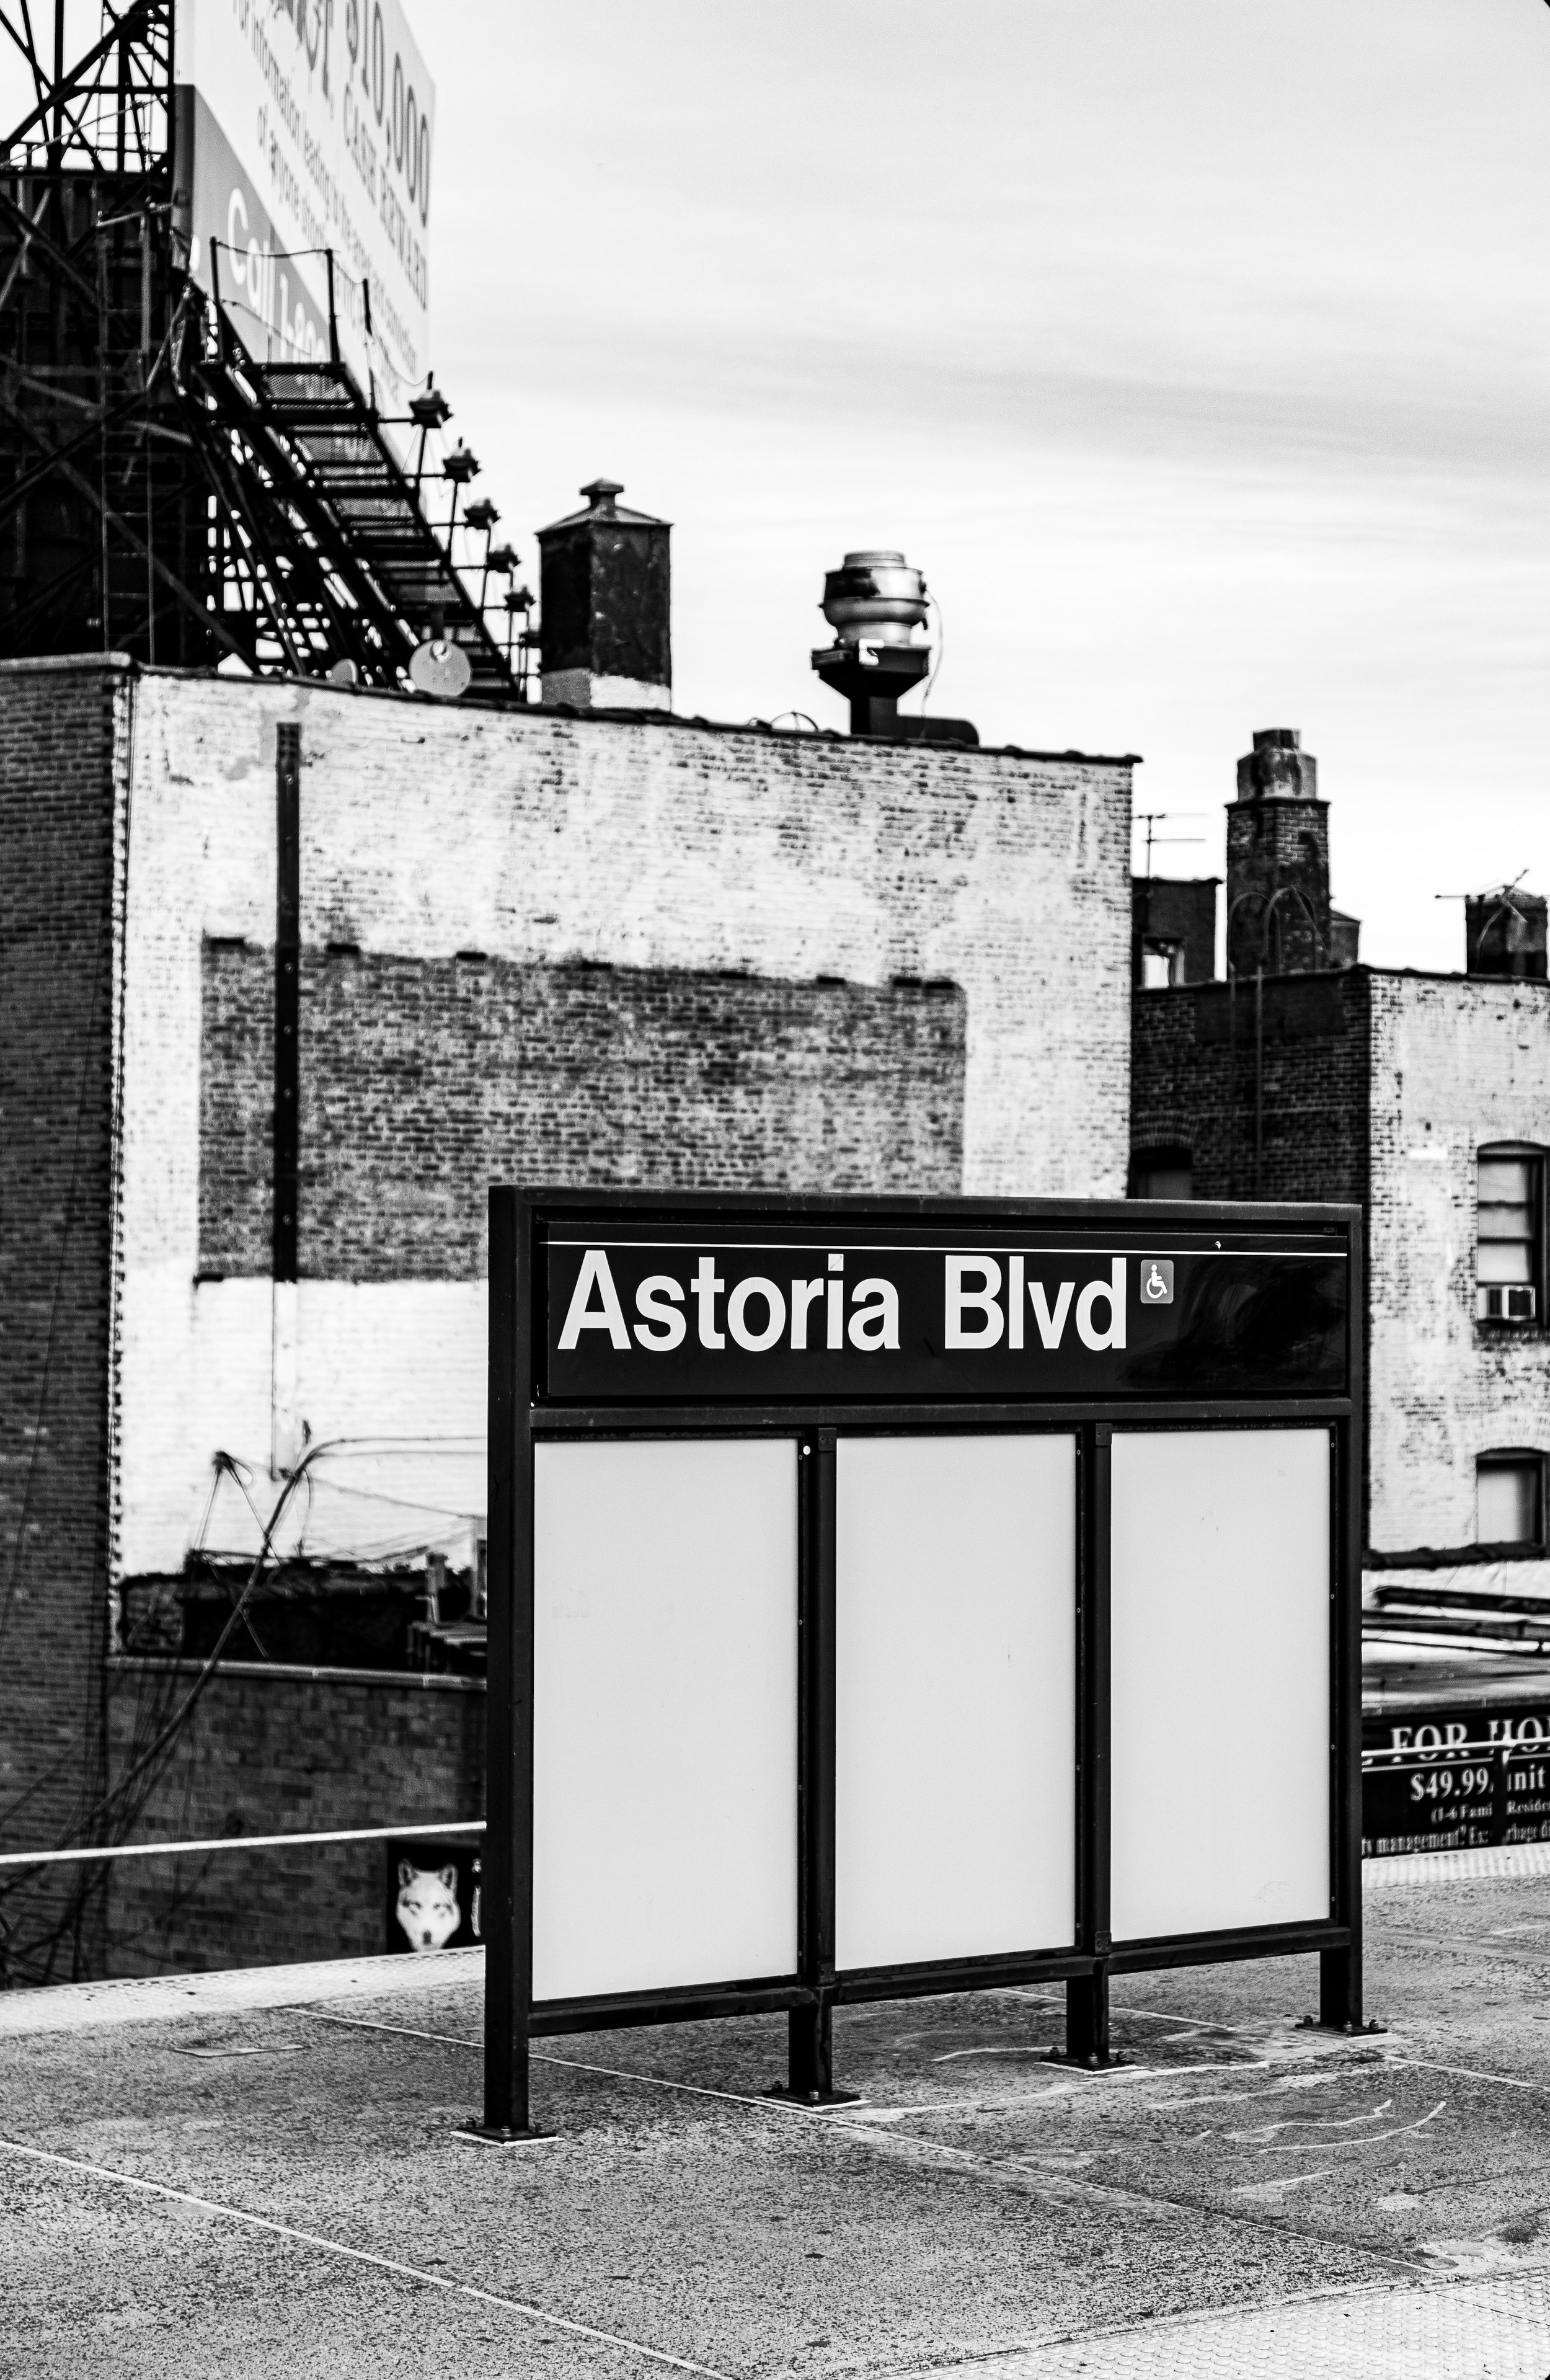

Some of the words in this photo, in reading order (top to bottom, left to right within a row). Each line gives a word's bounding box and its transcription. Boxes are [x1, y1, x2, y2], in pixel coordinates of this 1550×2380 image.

[228, 187, 275, 330] Call
[558, 1250, 901, 1352] Astoria
[944, 1255, 1127, 1352] Blvd
[1391, 1722, 1470, 1762] FOR
[1488, 1715, 1550, 1754] HO
[1507, 1798, 1550, 1816] Reside
